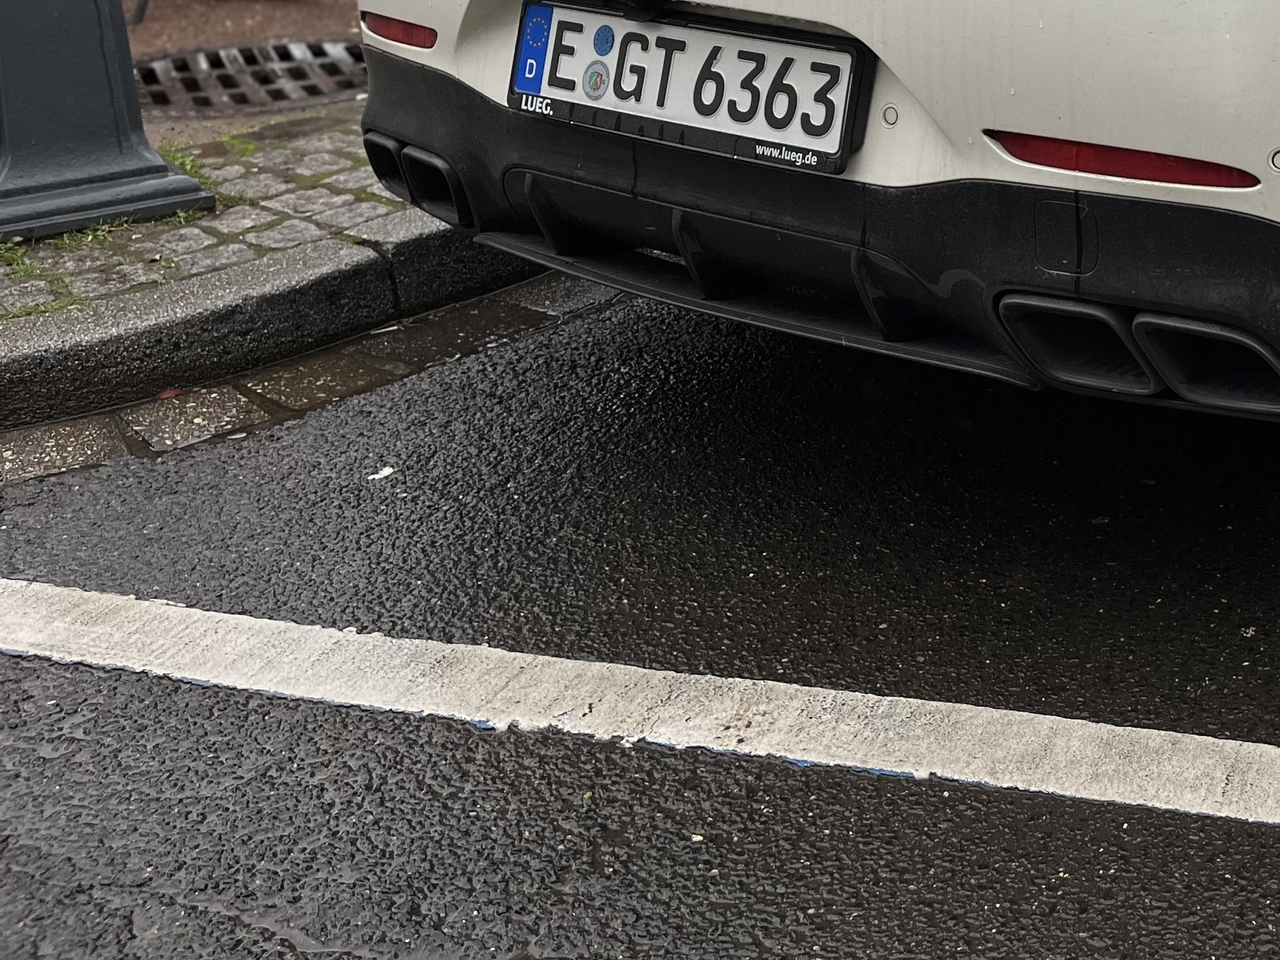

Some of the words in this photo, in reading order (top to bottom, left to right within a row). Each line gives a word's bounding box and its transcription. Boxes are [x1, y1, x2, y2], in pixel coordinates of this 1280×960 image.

[524, 58, 537, 80] D
[548, 19, 585, 91] E
[612, 31, 687, 108] GT
[693, 45, 842, 137] 6363
[520, 94, 554, 116] LUEG.
[755, 143, 818, 165] www.lueg.de
